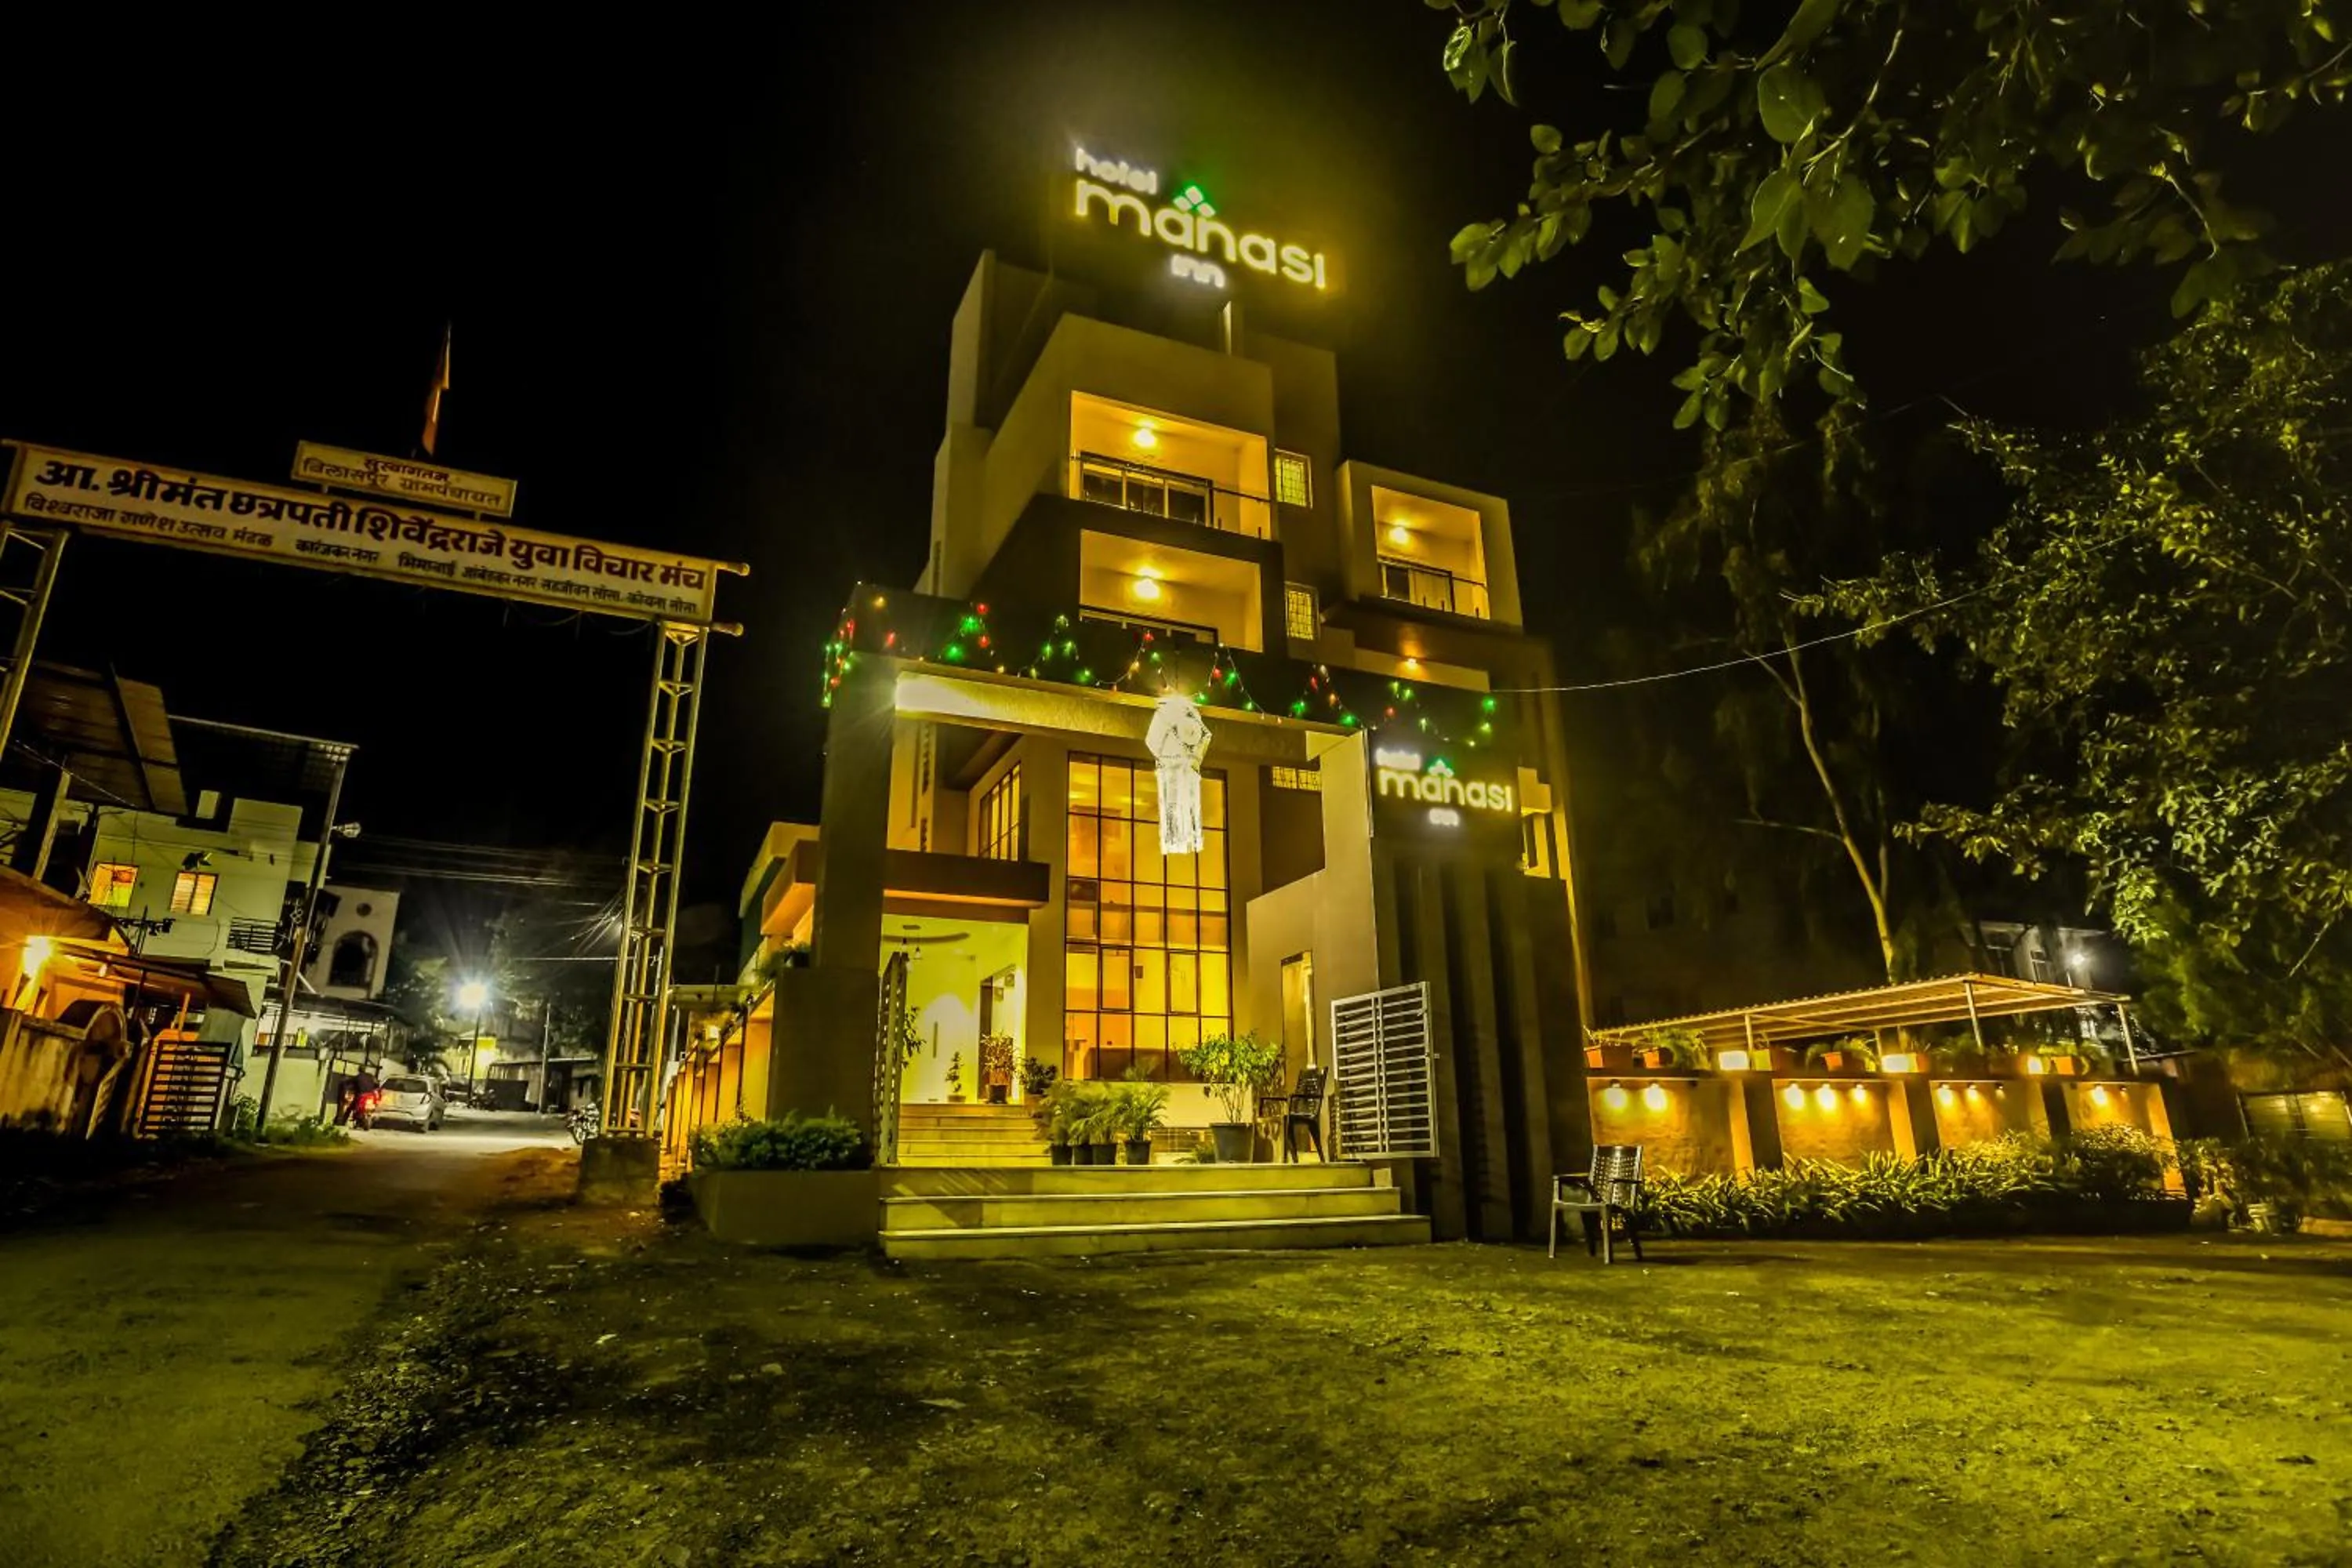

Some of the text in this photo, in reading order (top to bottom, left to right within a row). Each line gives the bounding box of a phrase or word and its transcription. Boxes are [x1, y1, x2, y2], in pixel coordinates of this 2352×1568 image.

[508, 537, 571, 571] युवा
[574, 543, 655, 584] विचार
[659, 559, 706, 591] मंच
